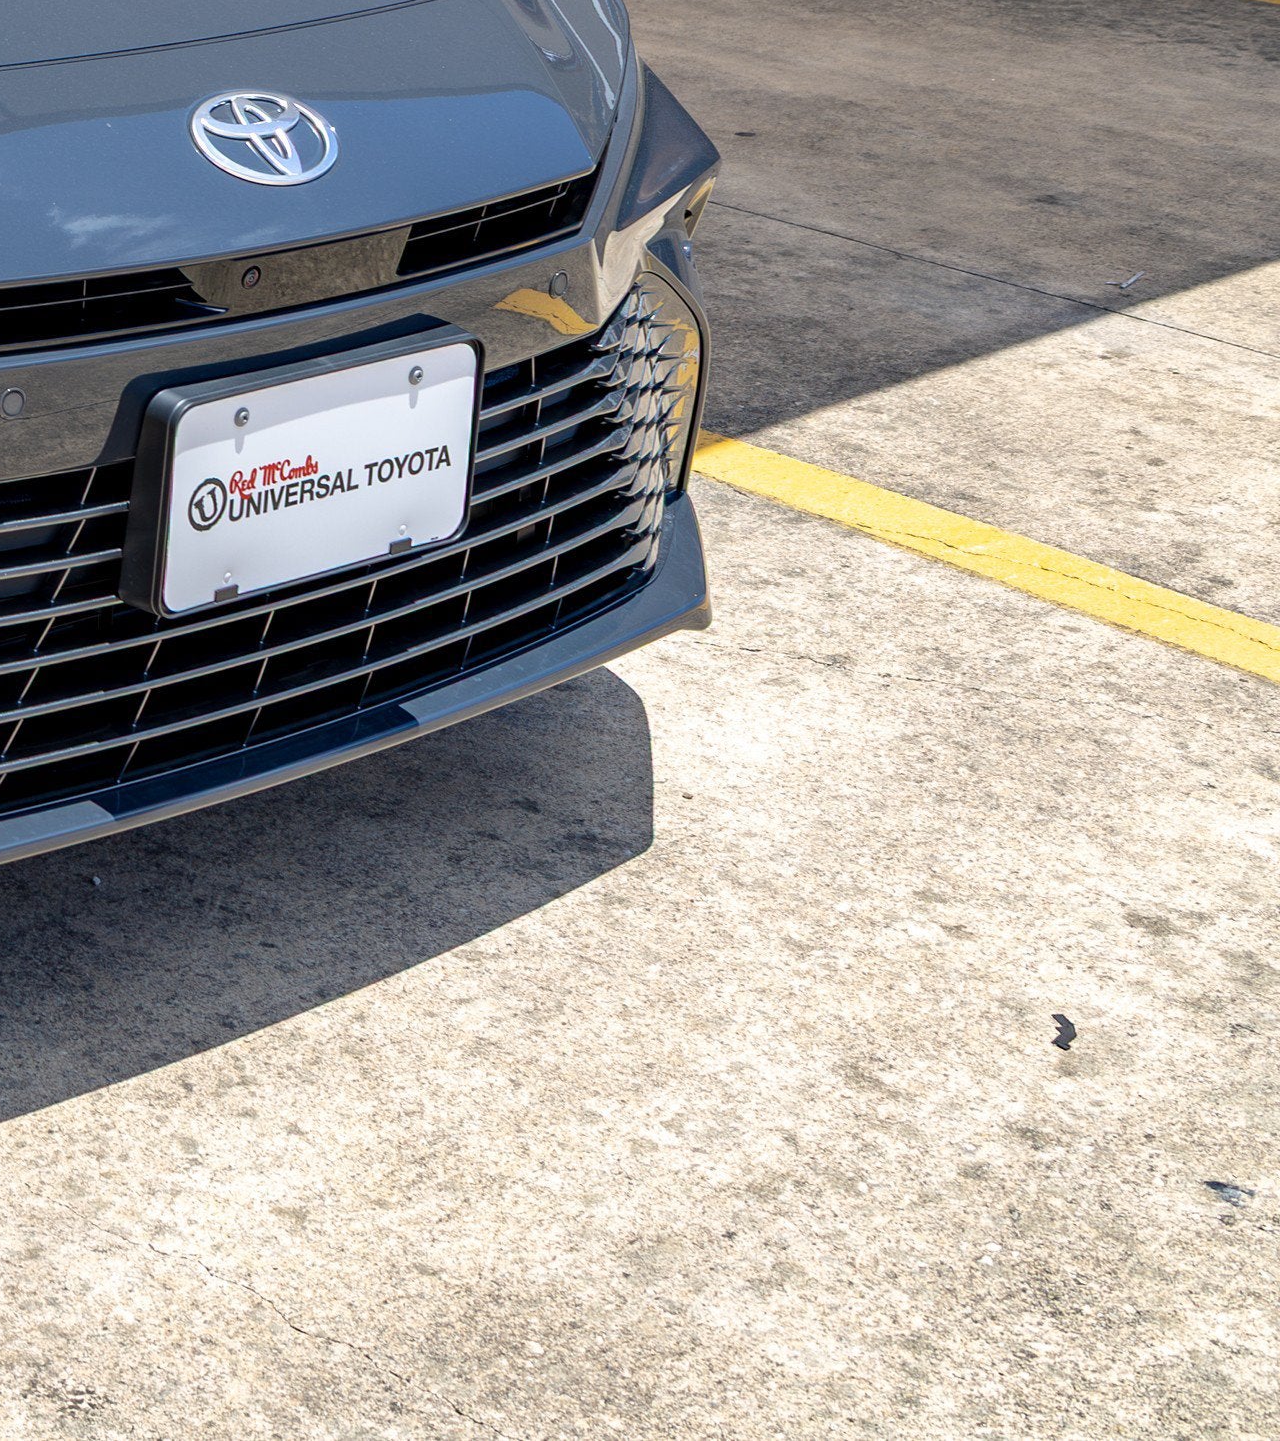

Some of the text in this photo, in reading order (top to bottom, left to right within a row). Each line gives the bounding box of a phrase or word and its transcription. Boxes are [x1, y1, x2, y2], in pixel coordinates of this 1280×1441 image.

[228, 444, 451, 522] UNIVERSAL TOYOTA
[229, 454, 319, 500] Red McCombs
